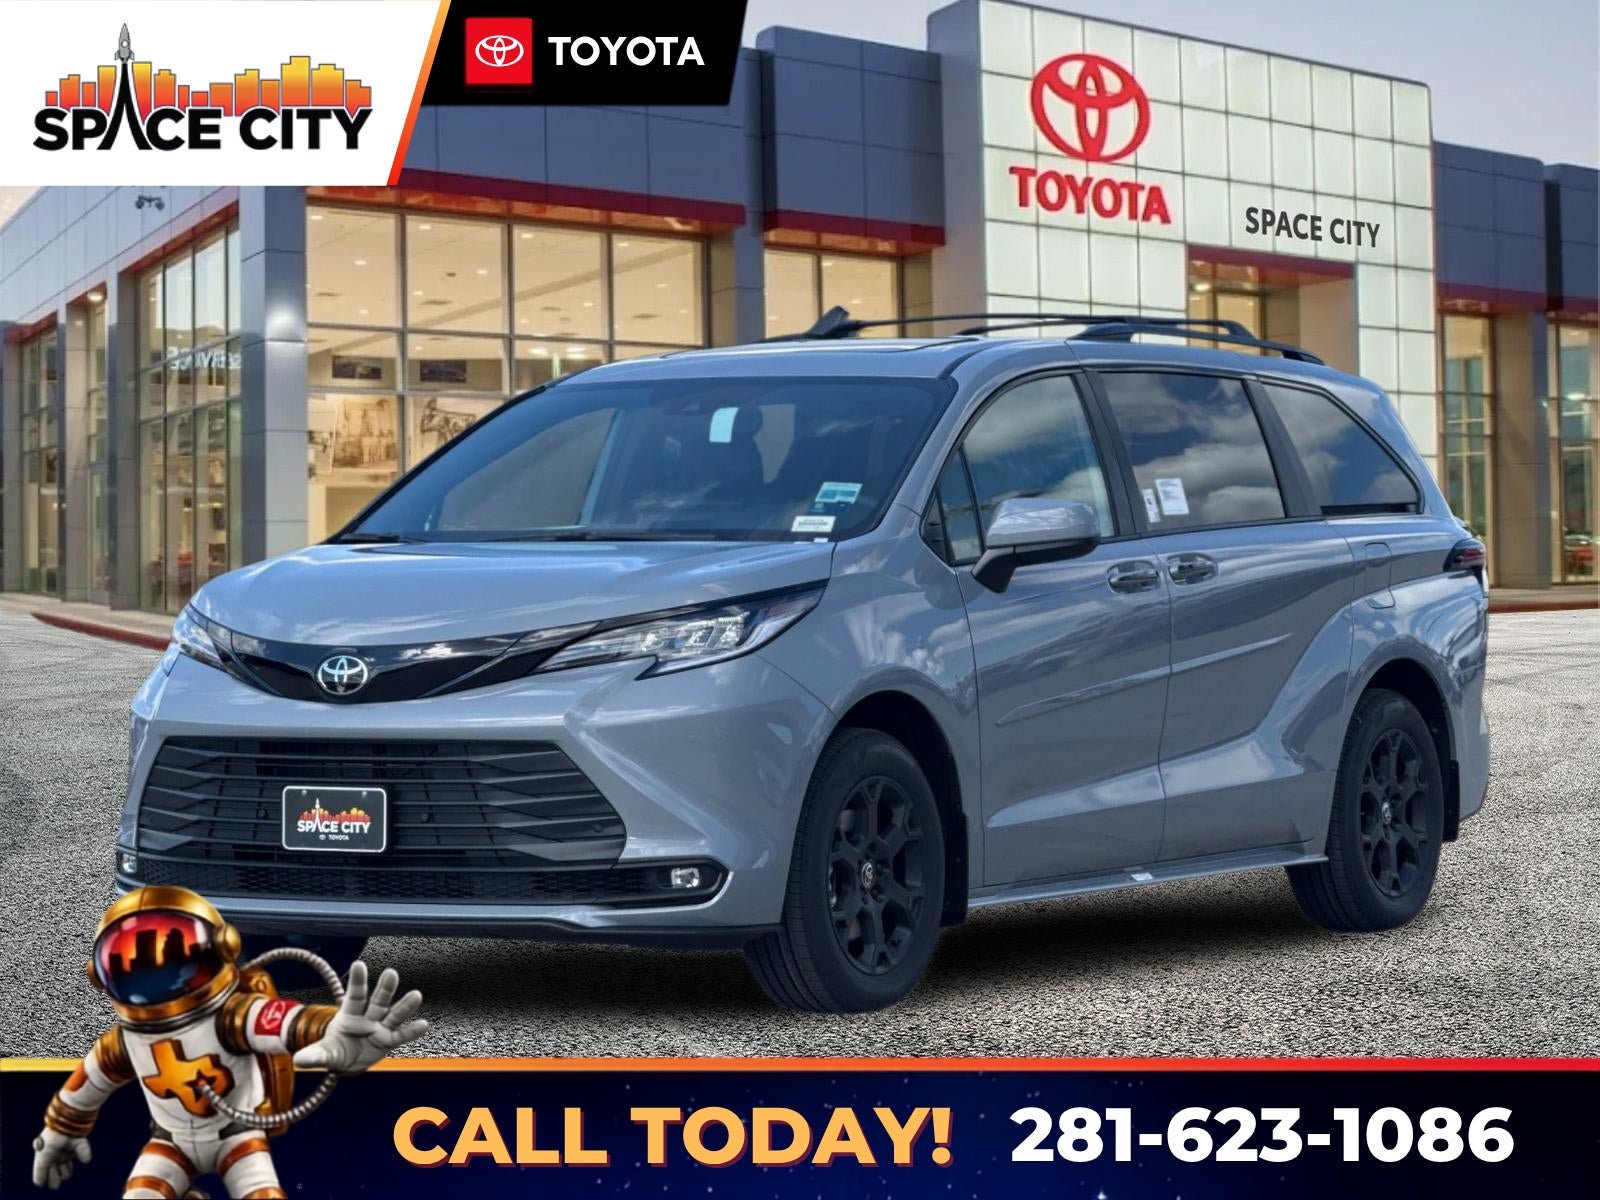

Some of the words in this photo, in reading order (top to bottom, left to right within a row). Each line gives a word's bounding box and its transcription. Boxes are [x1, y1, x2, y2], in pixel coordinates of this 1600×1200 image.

[1009, 166, 1171, 225] TOYOTA
[1245, 207, 1322, 242] SPACE
[1330, 218, 1380, 248] CITY
[297, 820, 338, 833] SPACE
[341, 822, 371, 834] CITY
